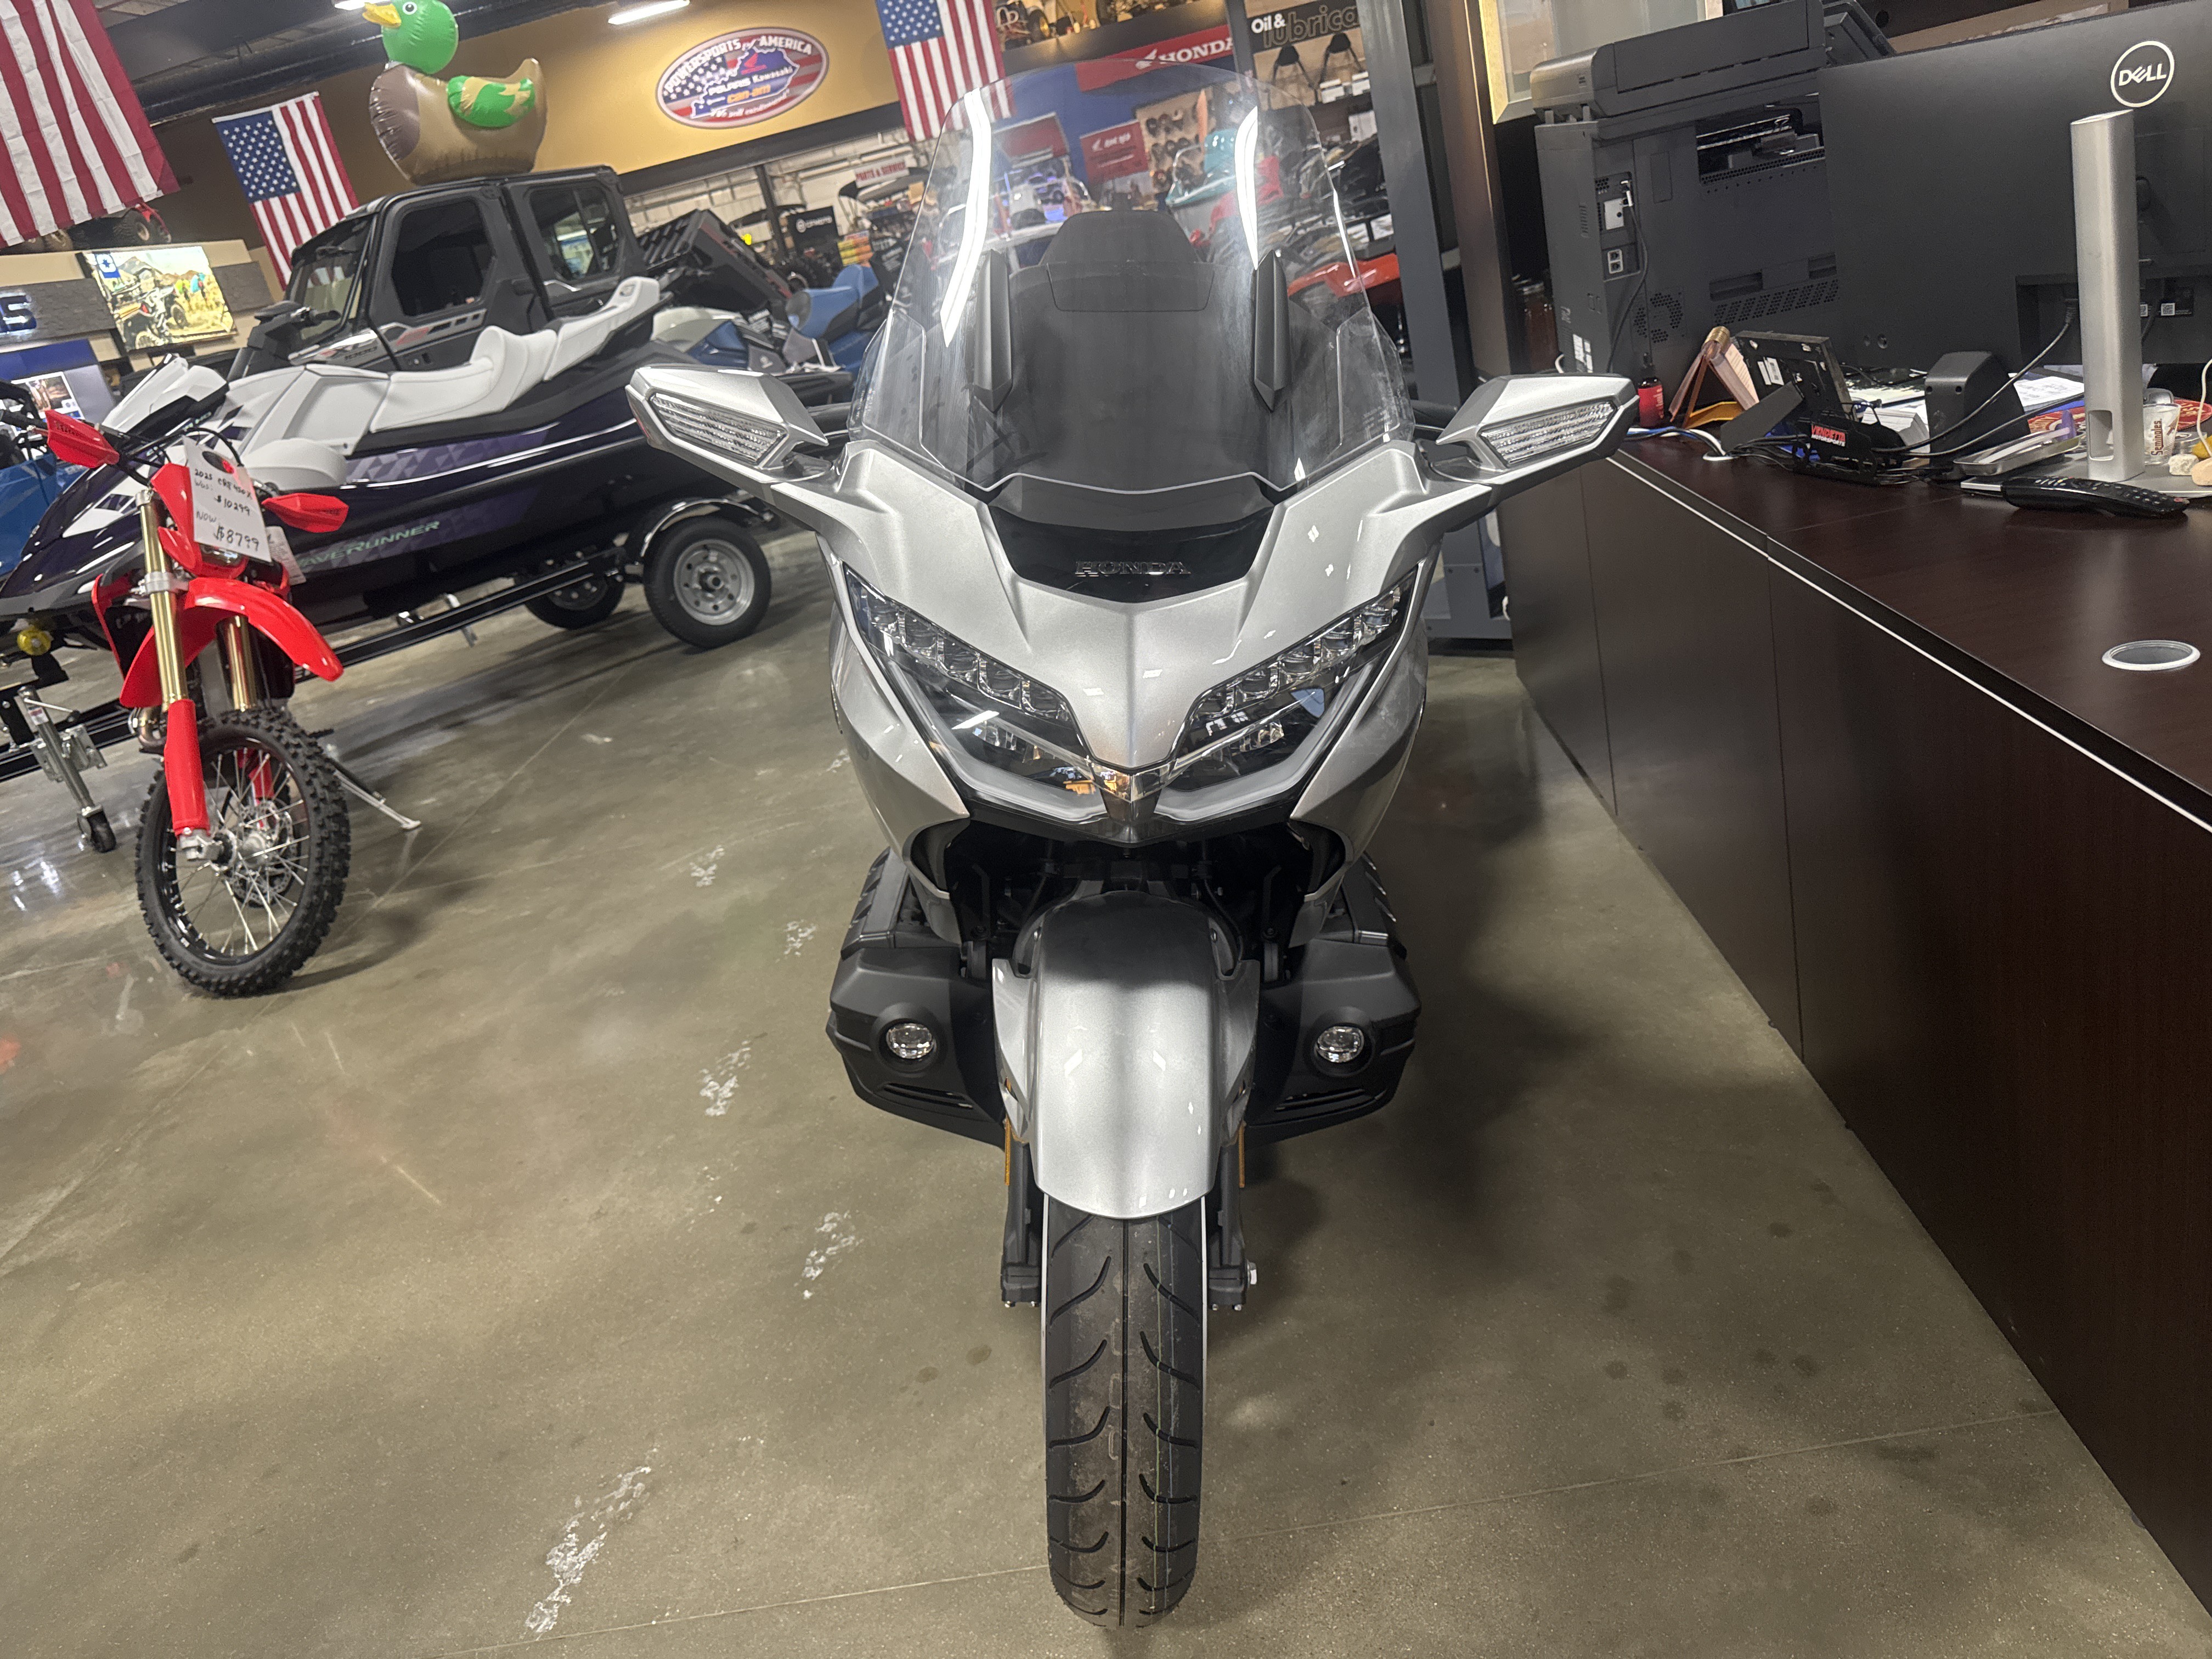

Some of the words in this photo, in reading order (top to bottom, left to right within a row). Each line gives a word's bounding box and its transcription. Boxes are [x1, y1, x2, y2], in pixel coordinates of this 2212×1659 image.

[1251, 15, 1272, 33] Oil
[1274, 13, 1286, 28] &
[664, 38, 741, 93] POWERSPORTS
[759, 35, 812, 55] AMERICA
[2119, 63, 2167, 86] DELL
[1811, 424, 1846, 442] VENDETTA
[2151, 420, 2163, 456] Seminoles
[195, 469, 213, 481] 2025
[196, 510, 217, 523] NOW
[213, 524, 259, 551] $8799
[299, 521, 440, 568] AVERUNNER
[1075, 561, 1192, 575] HONDA
